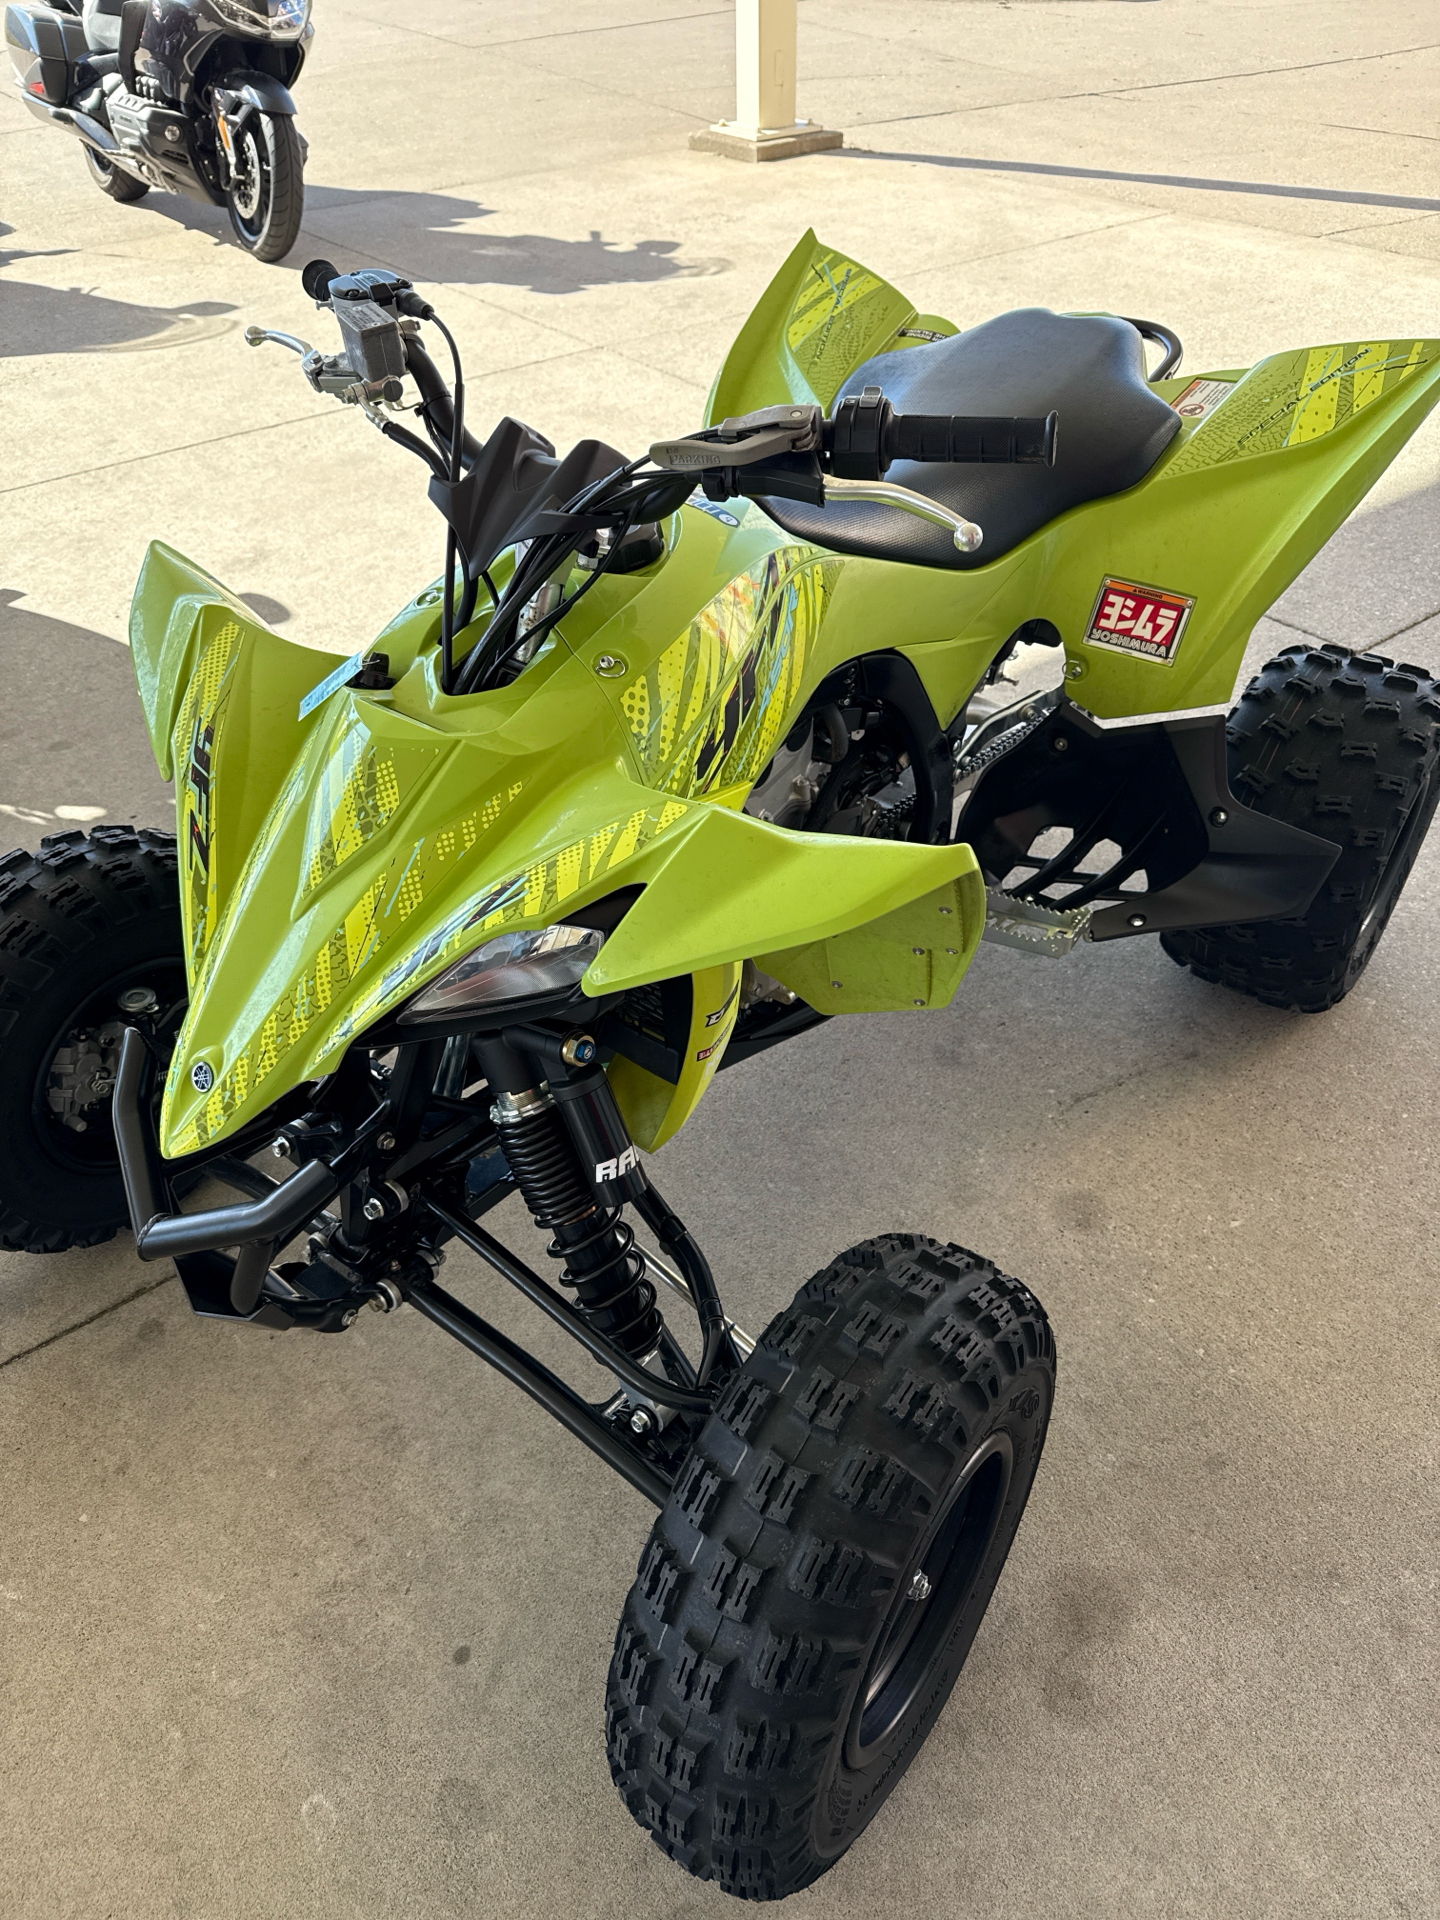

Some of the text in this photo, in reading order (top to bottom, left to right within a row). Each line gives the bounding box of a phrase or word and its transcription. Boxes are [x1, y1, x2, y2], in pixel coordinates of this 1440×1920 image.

[1237, 393, 1309, 446] SPECIAL
[1310, 347, 1371, 392] EDITION
[668, 454, 721, 466] PARKING
[1099, 593, 1178, 643] ヨシムラ
[1091, 628, 1167, 657] YOSHIMURA
[595, 1143, 640, 1183] RA
